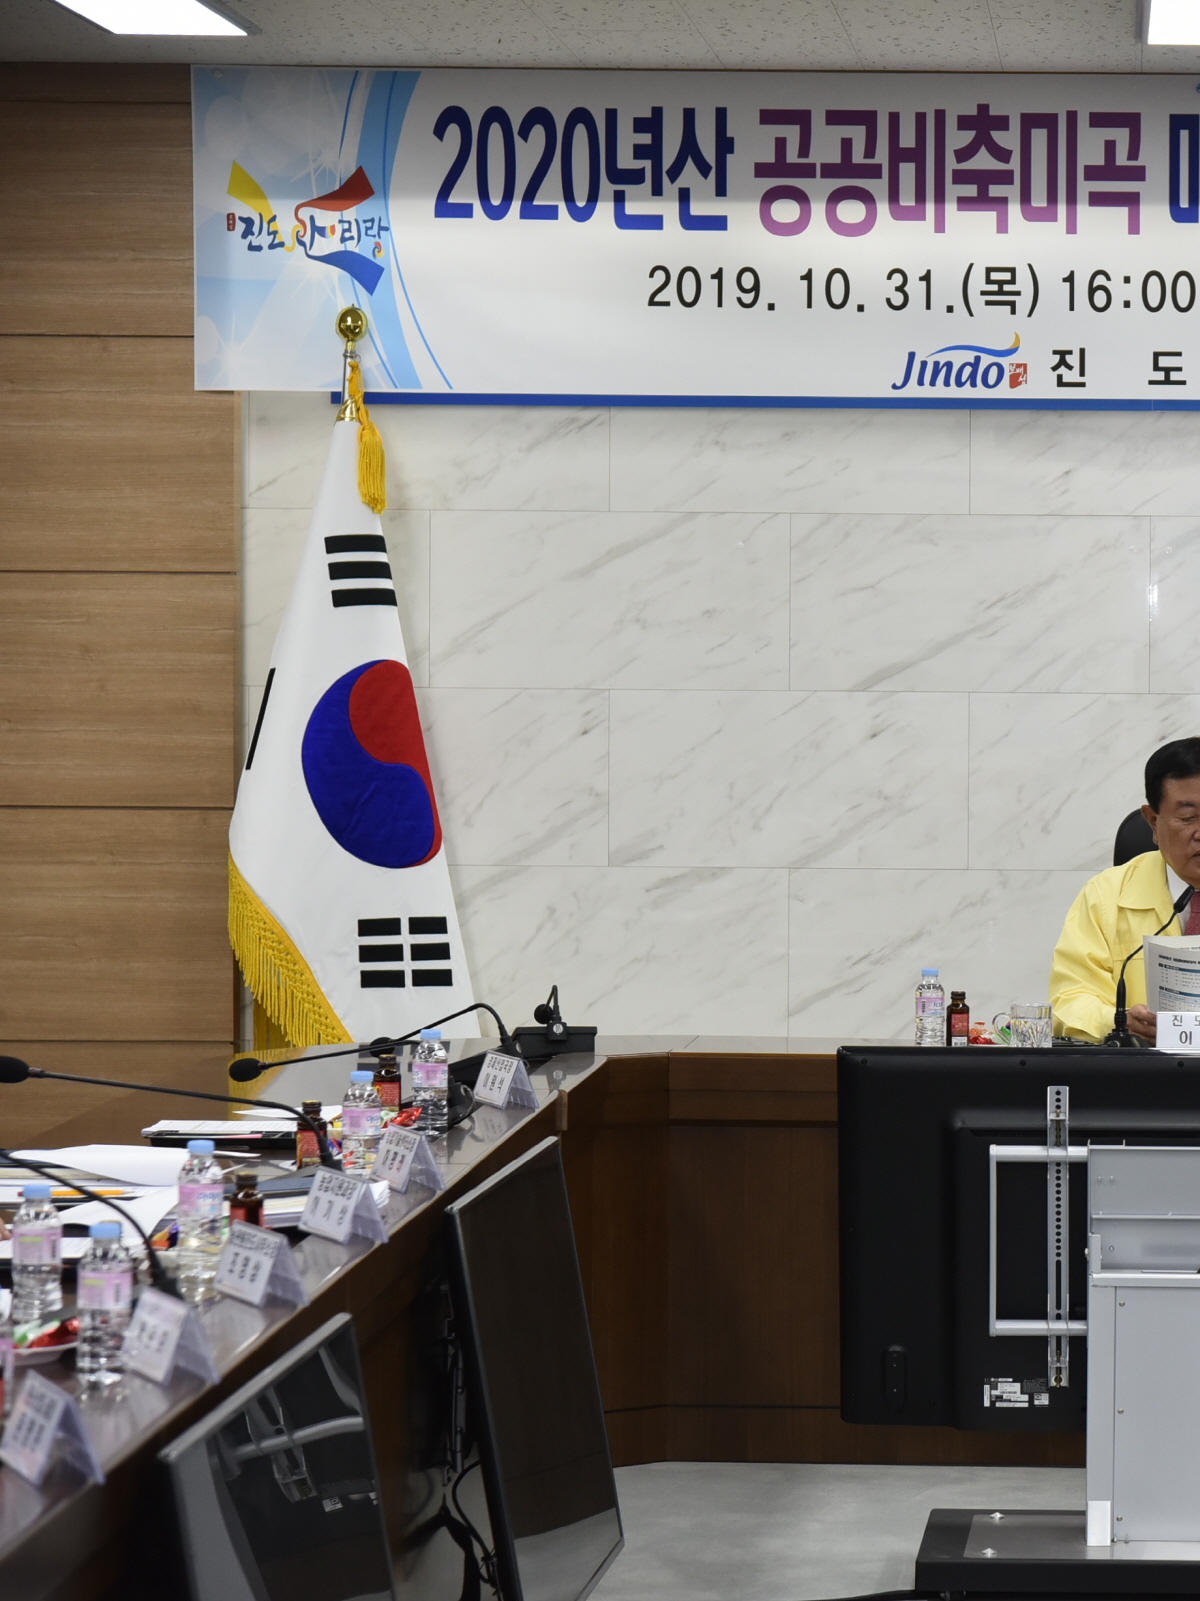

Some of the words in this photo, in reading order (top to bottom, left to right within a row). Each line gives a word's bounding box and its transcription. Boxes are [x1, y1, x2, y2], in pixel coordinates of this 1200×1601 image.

[432, 104, 735, 231] 2020년산
[753, 102, 1147, 238] 공공비축미곡
[238, 212, 285, 252] 진도
[647, 264, 776, 312] 2019.
[799, 266, 865, 313] 10.
[1062, 268, 1196, 313] 16:00
[891, 350, 1005, 391] Jindo
